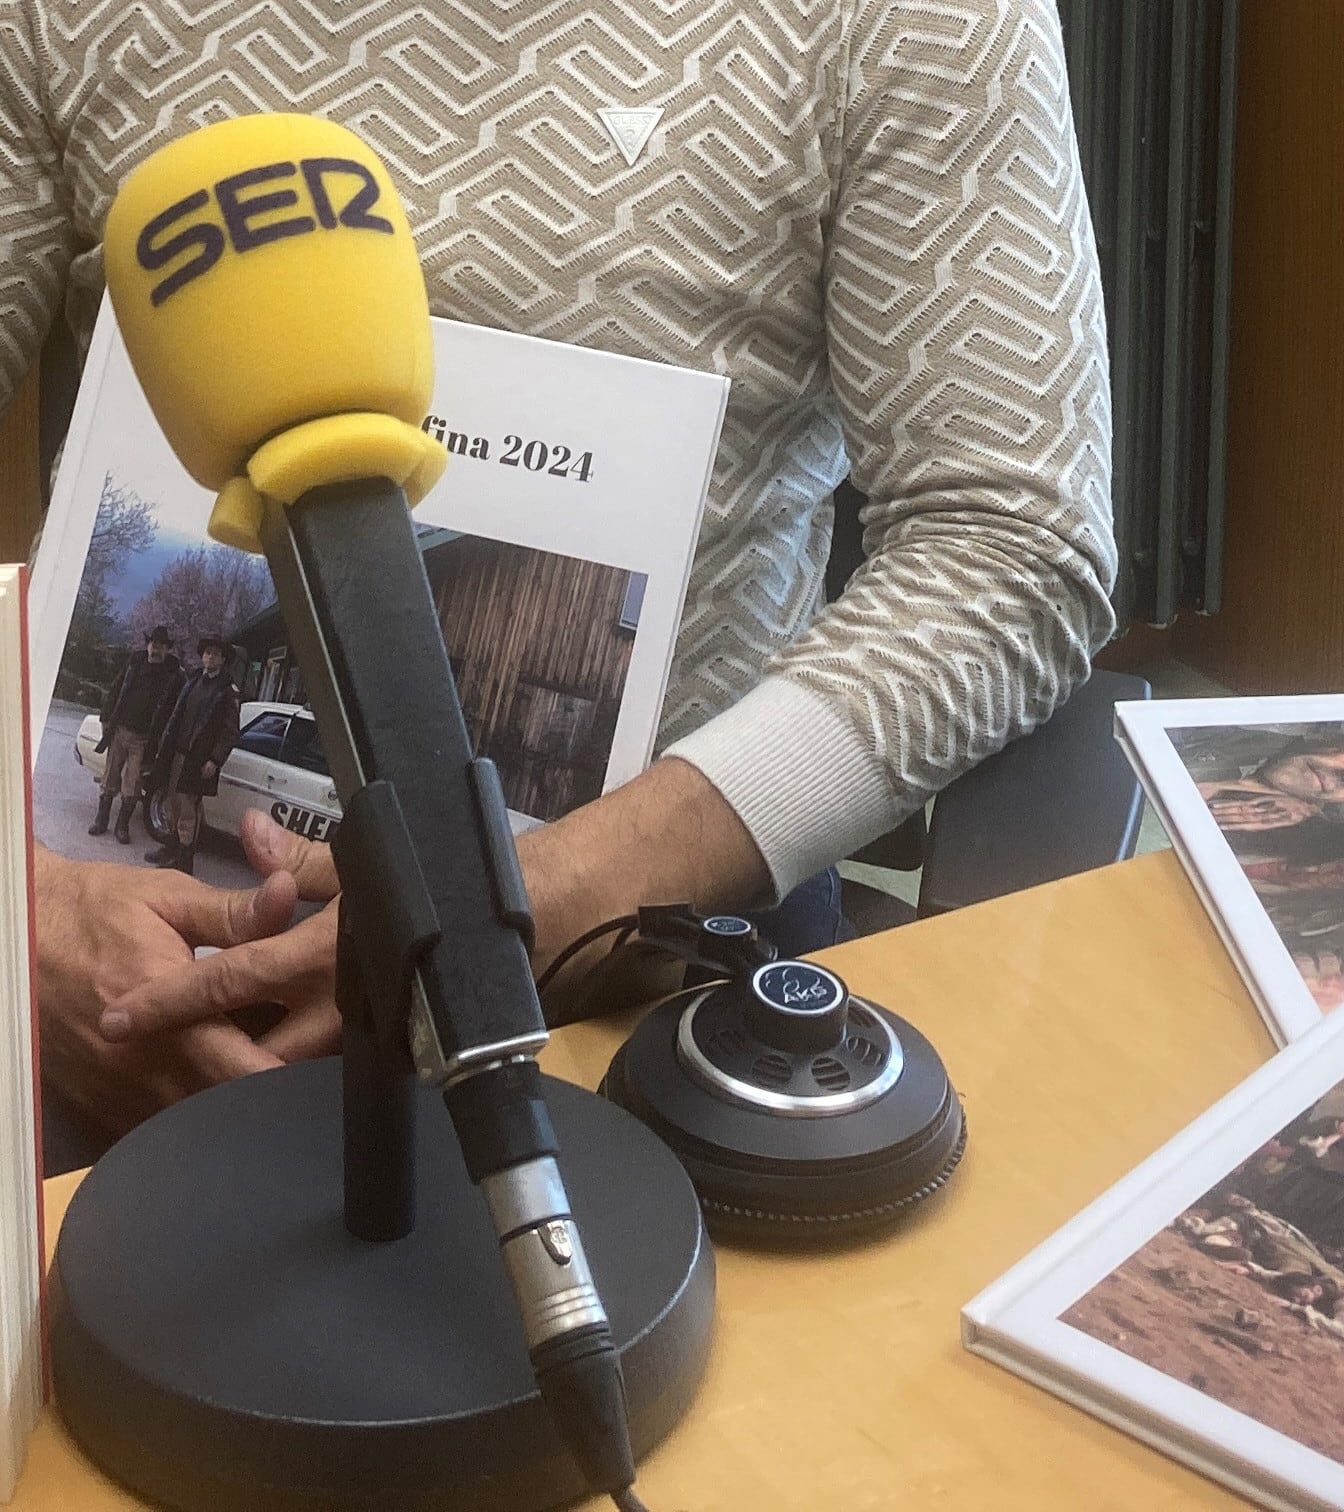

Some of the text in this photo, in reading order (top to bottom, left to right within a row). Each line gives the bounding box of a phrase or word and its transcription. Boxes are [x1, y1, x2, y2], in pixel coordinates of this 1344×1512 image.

[136, 157, 395, 308] SER
[499, 434, 594, 483] 2024
[271, 802, 339, 842] SHE
